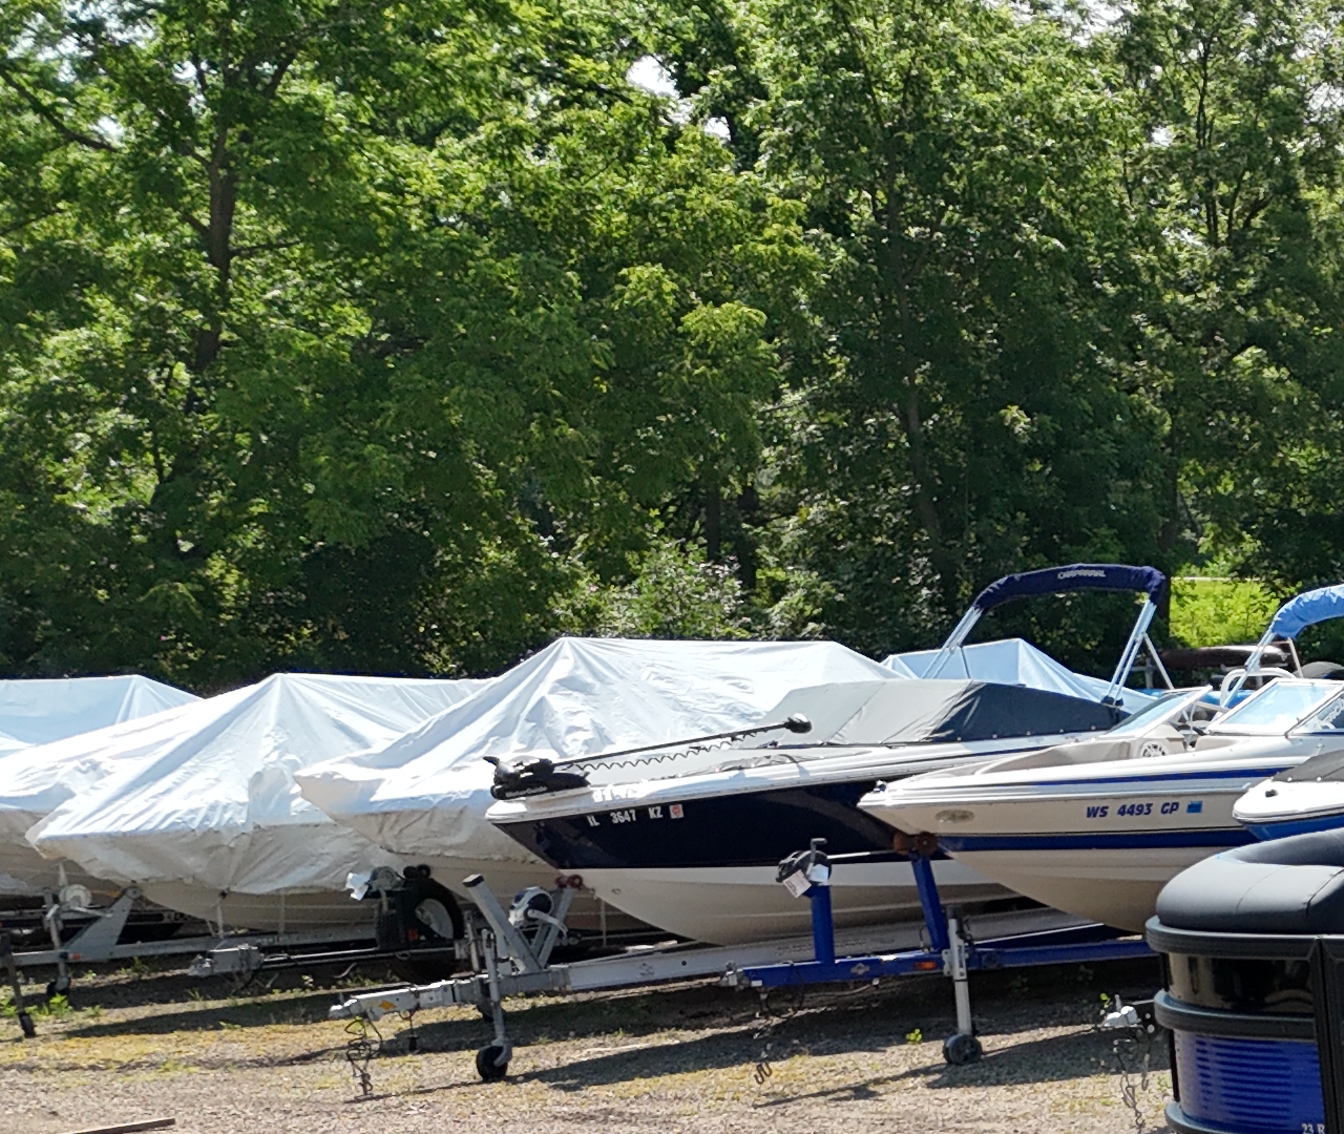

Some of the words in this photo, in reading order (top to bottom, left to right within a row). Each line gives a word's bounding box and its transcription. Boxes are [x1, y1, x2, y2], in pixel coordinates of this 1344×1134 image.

[610, 809, 636, 824] 3647
[648, 806, 663, 819] KZ
[1086, 806, 1109, 818] WS
[1117, 803, 1153, 816] 4493
[1160, 802, 1180, 814] GP
